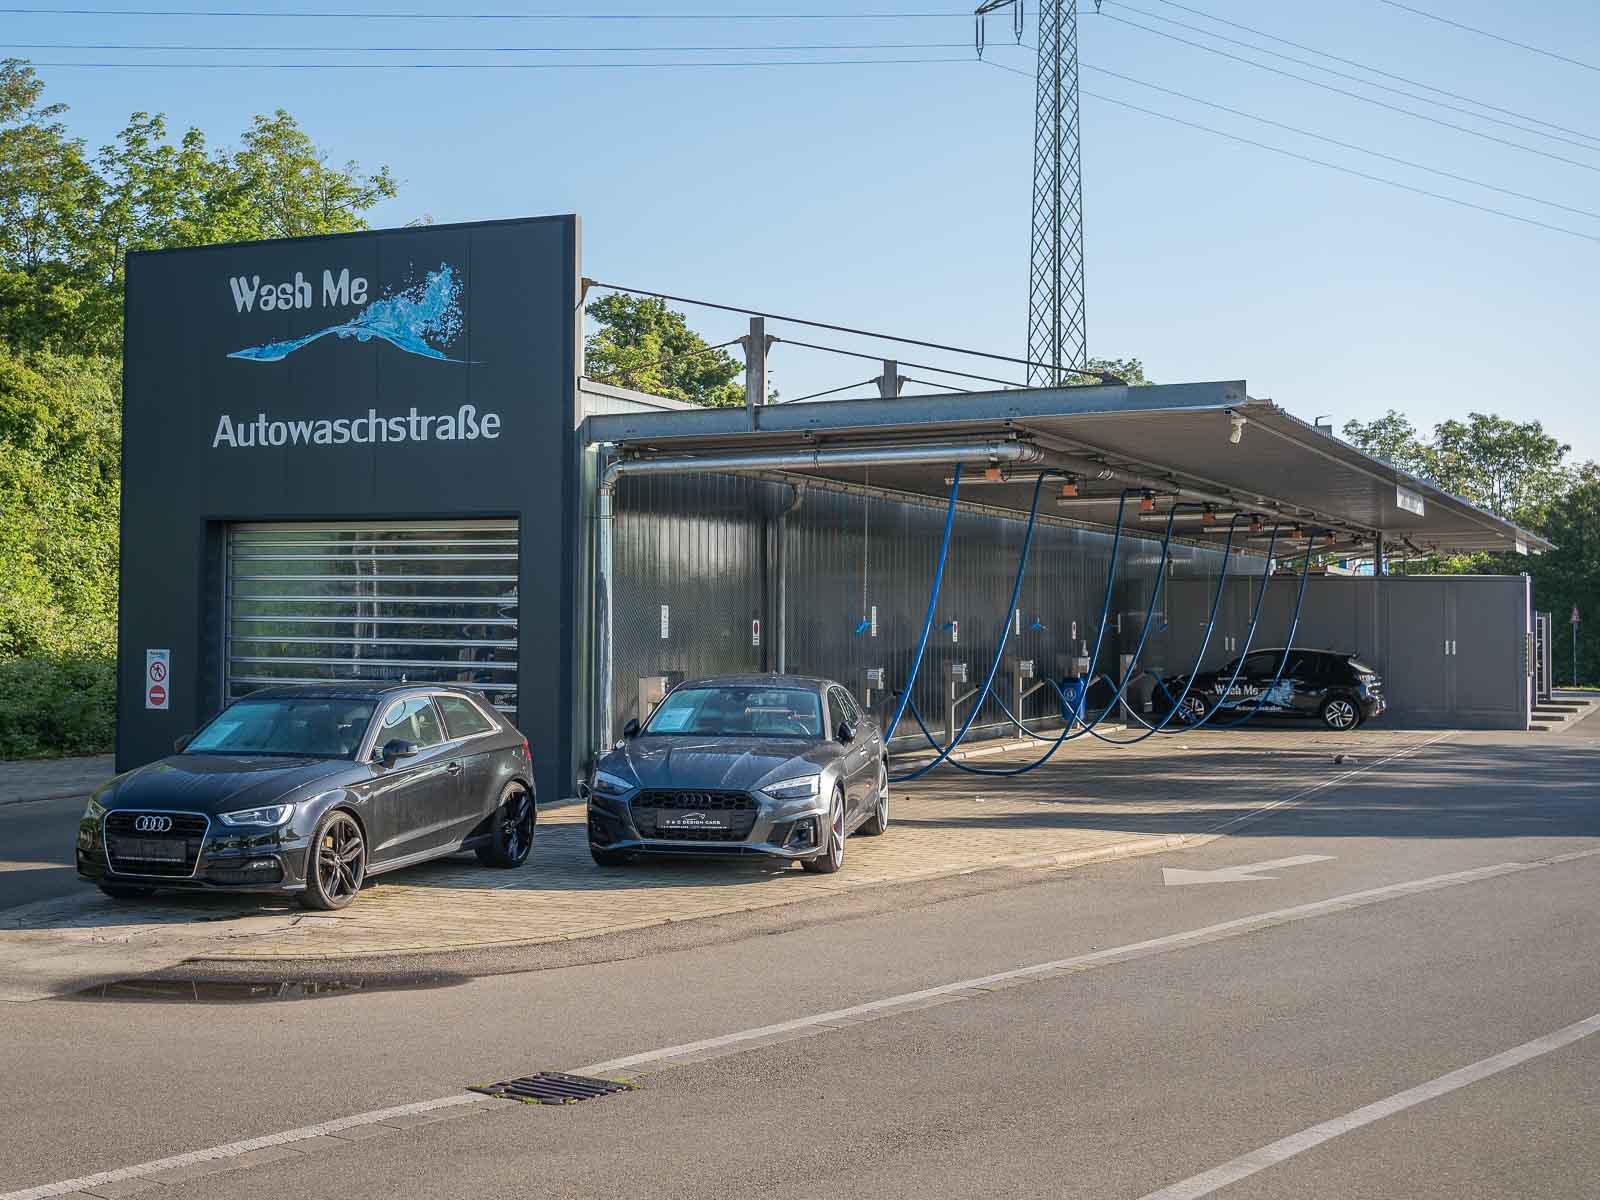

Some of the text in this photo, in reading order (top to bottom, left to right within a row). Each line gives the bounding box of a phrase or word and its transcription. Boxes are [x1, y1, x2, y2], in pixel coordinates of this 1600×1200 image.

[230, 268, 368, 313] Wash Me
[212, 404, 501, 448] Autowaschstraße
[1243, 684, 1259, 696] Me
